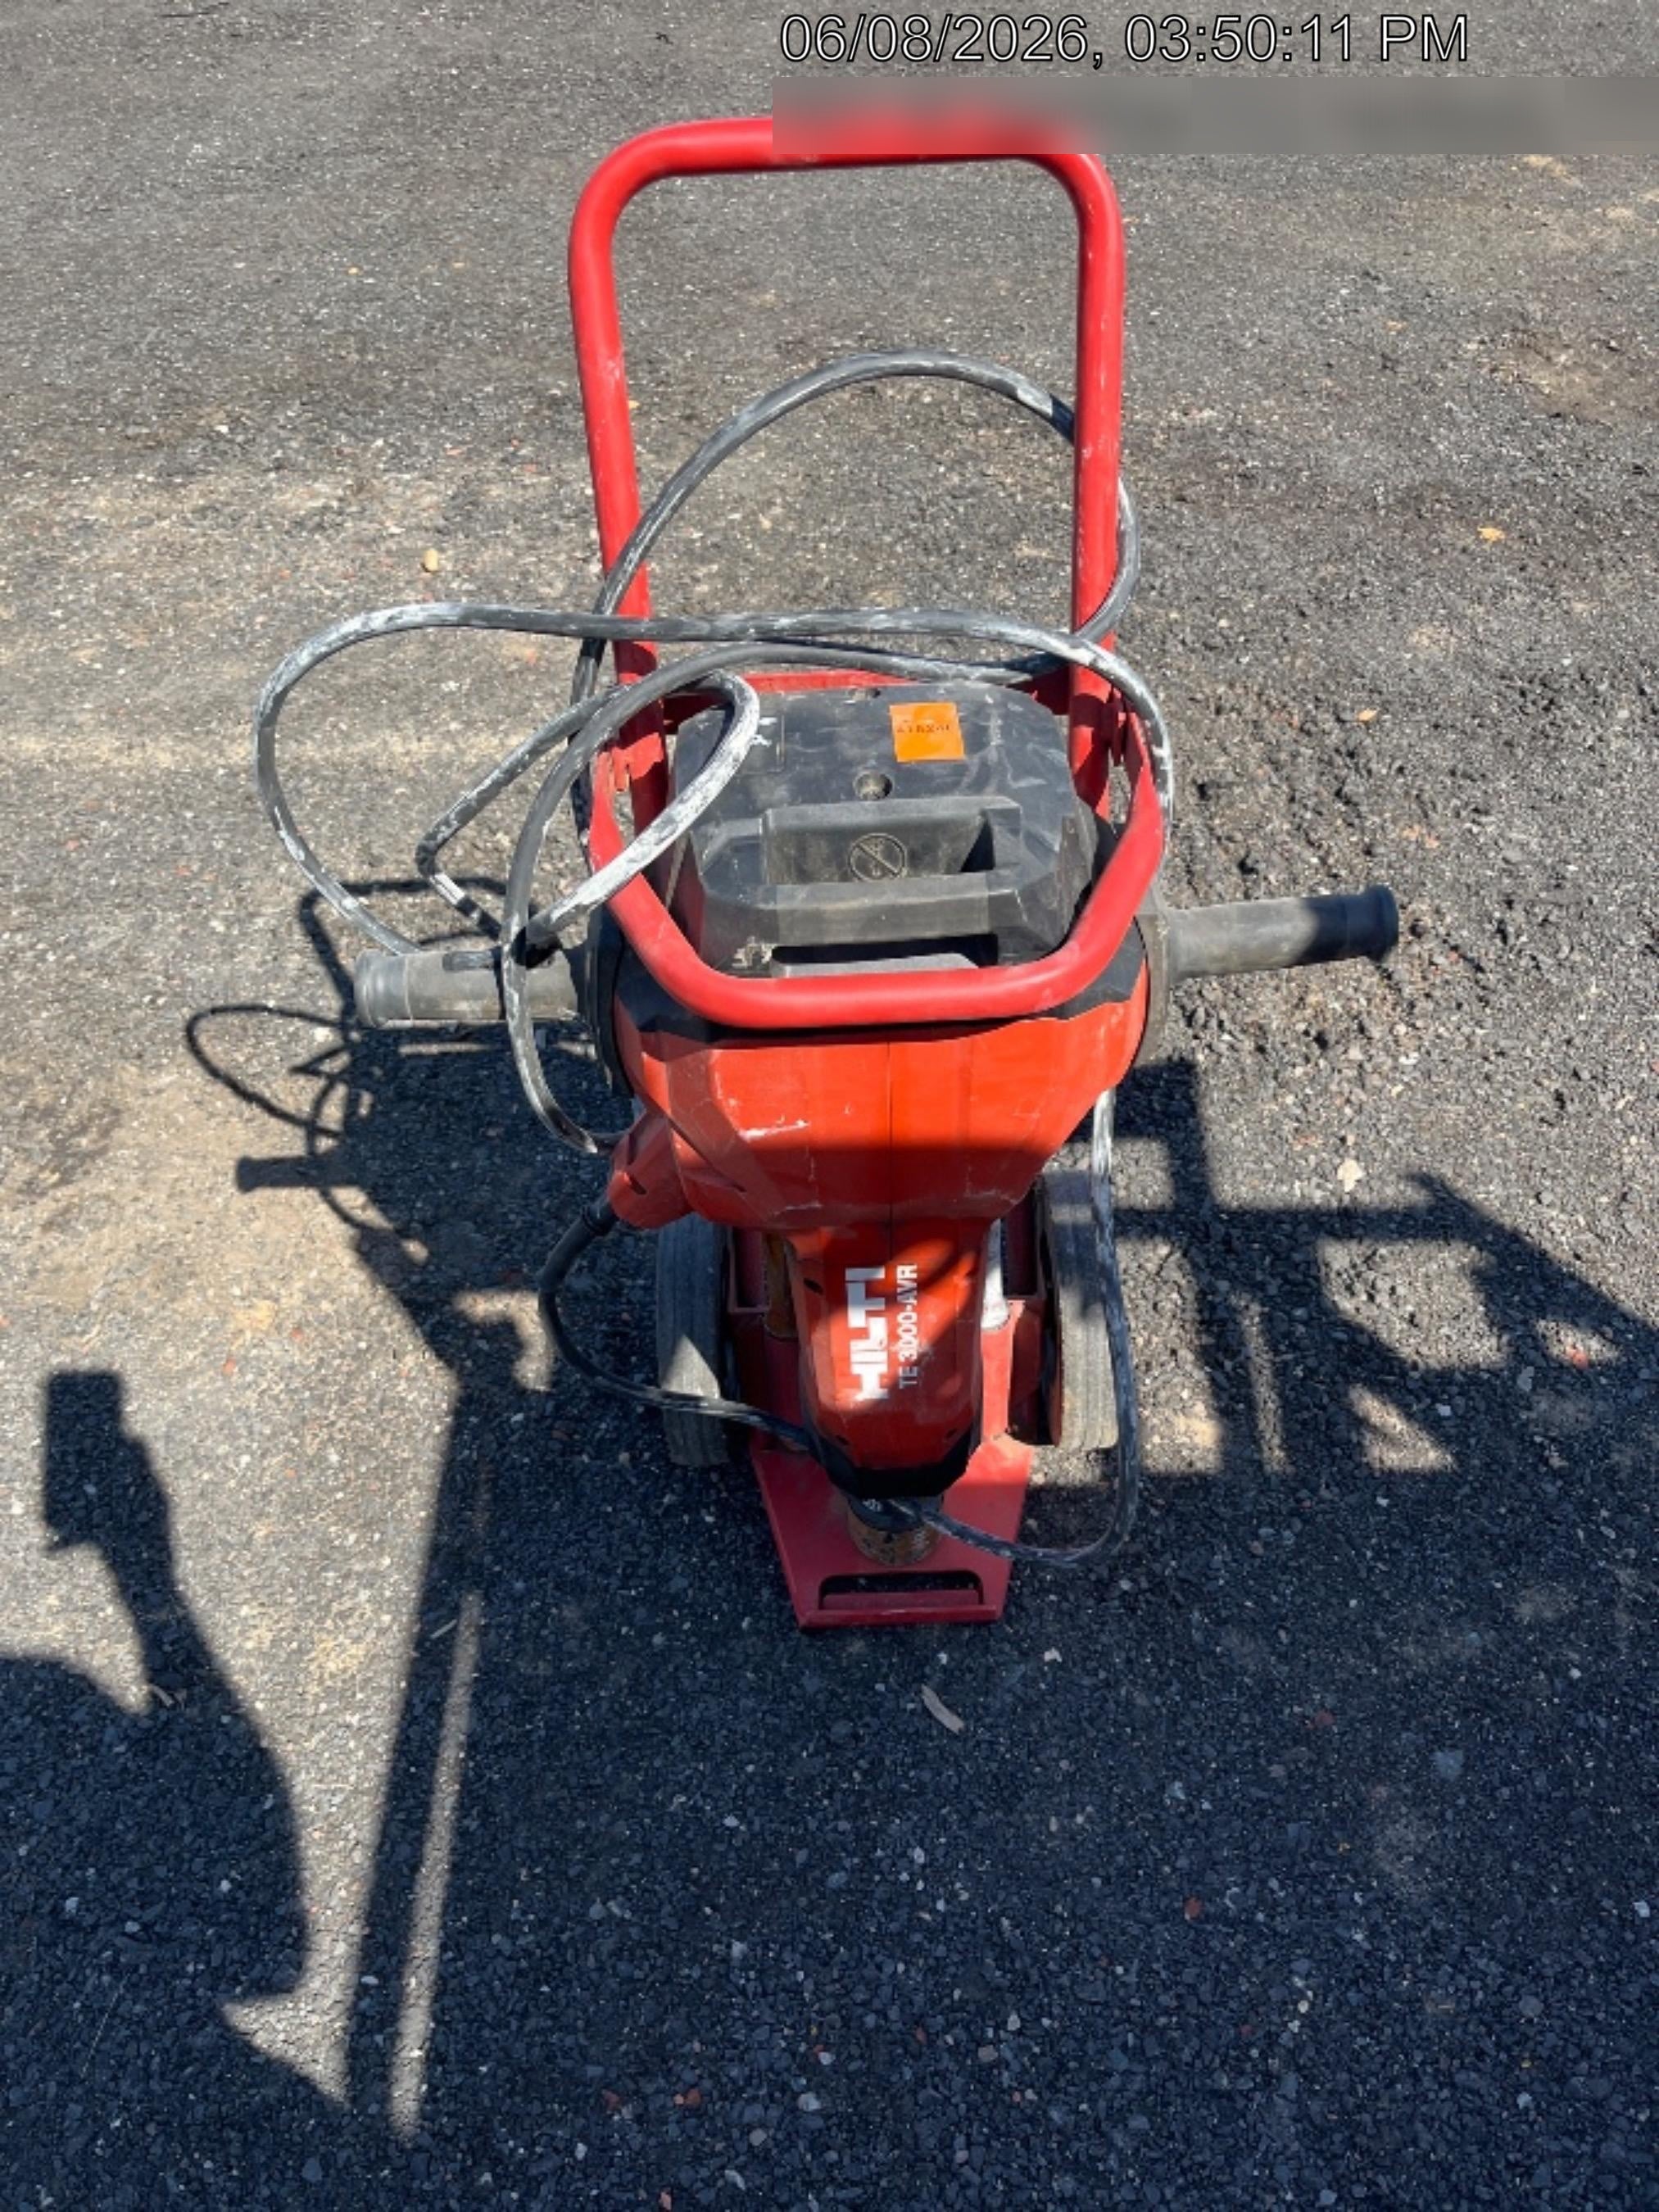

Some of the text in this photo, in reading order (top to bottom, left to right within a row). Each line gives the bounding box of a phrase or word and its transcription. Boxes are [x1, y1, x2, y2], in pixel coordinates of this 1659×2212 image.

[845, 1267, 889, 1401] HILTI
[896, 1264, 918, 1389] TE 3000-AVR
